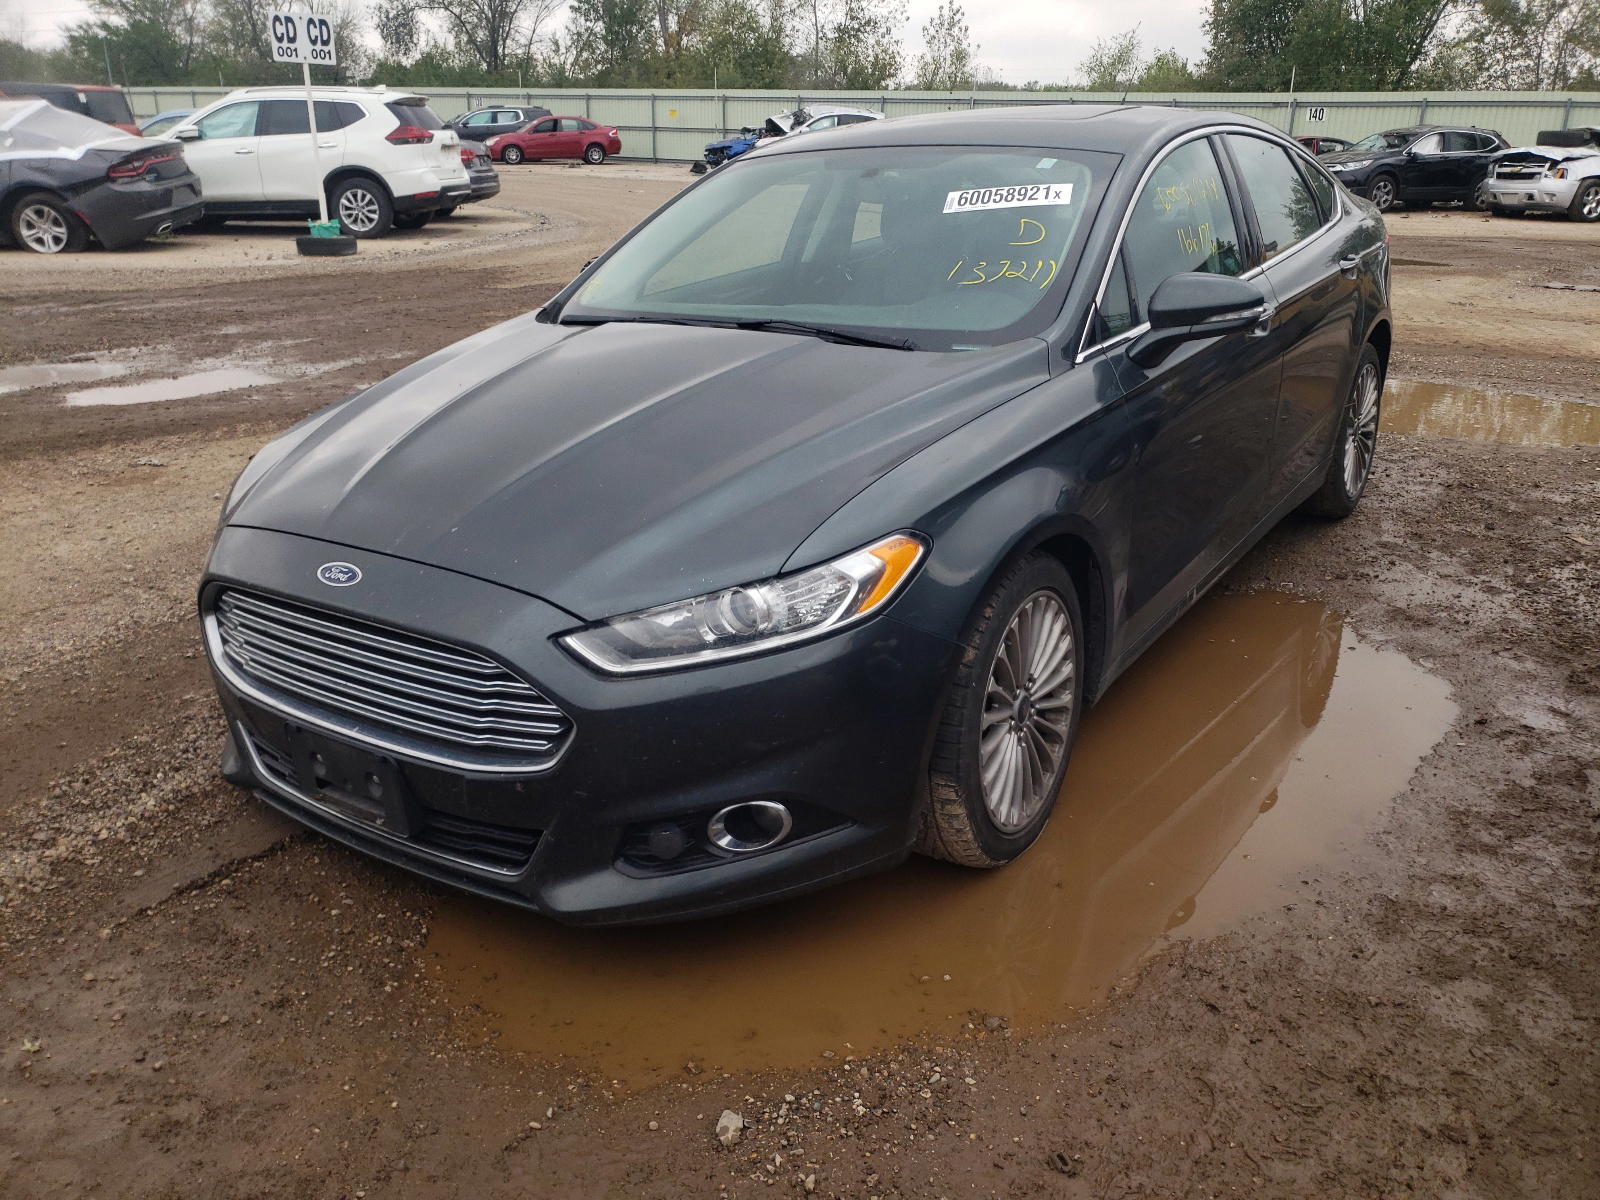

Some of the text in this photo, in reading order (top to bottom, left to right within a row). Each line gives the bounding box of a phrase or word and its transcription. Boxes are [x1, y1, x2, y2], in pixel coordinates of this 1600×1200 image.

[272, 14, 331, 46] CD CD
[277, 46, 332, 60] 001 001
[1308, 107, 1325, 121] 140
[325, 566, 352, 581] Ford
